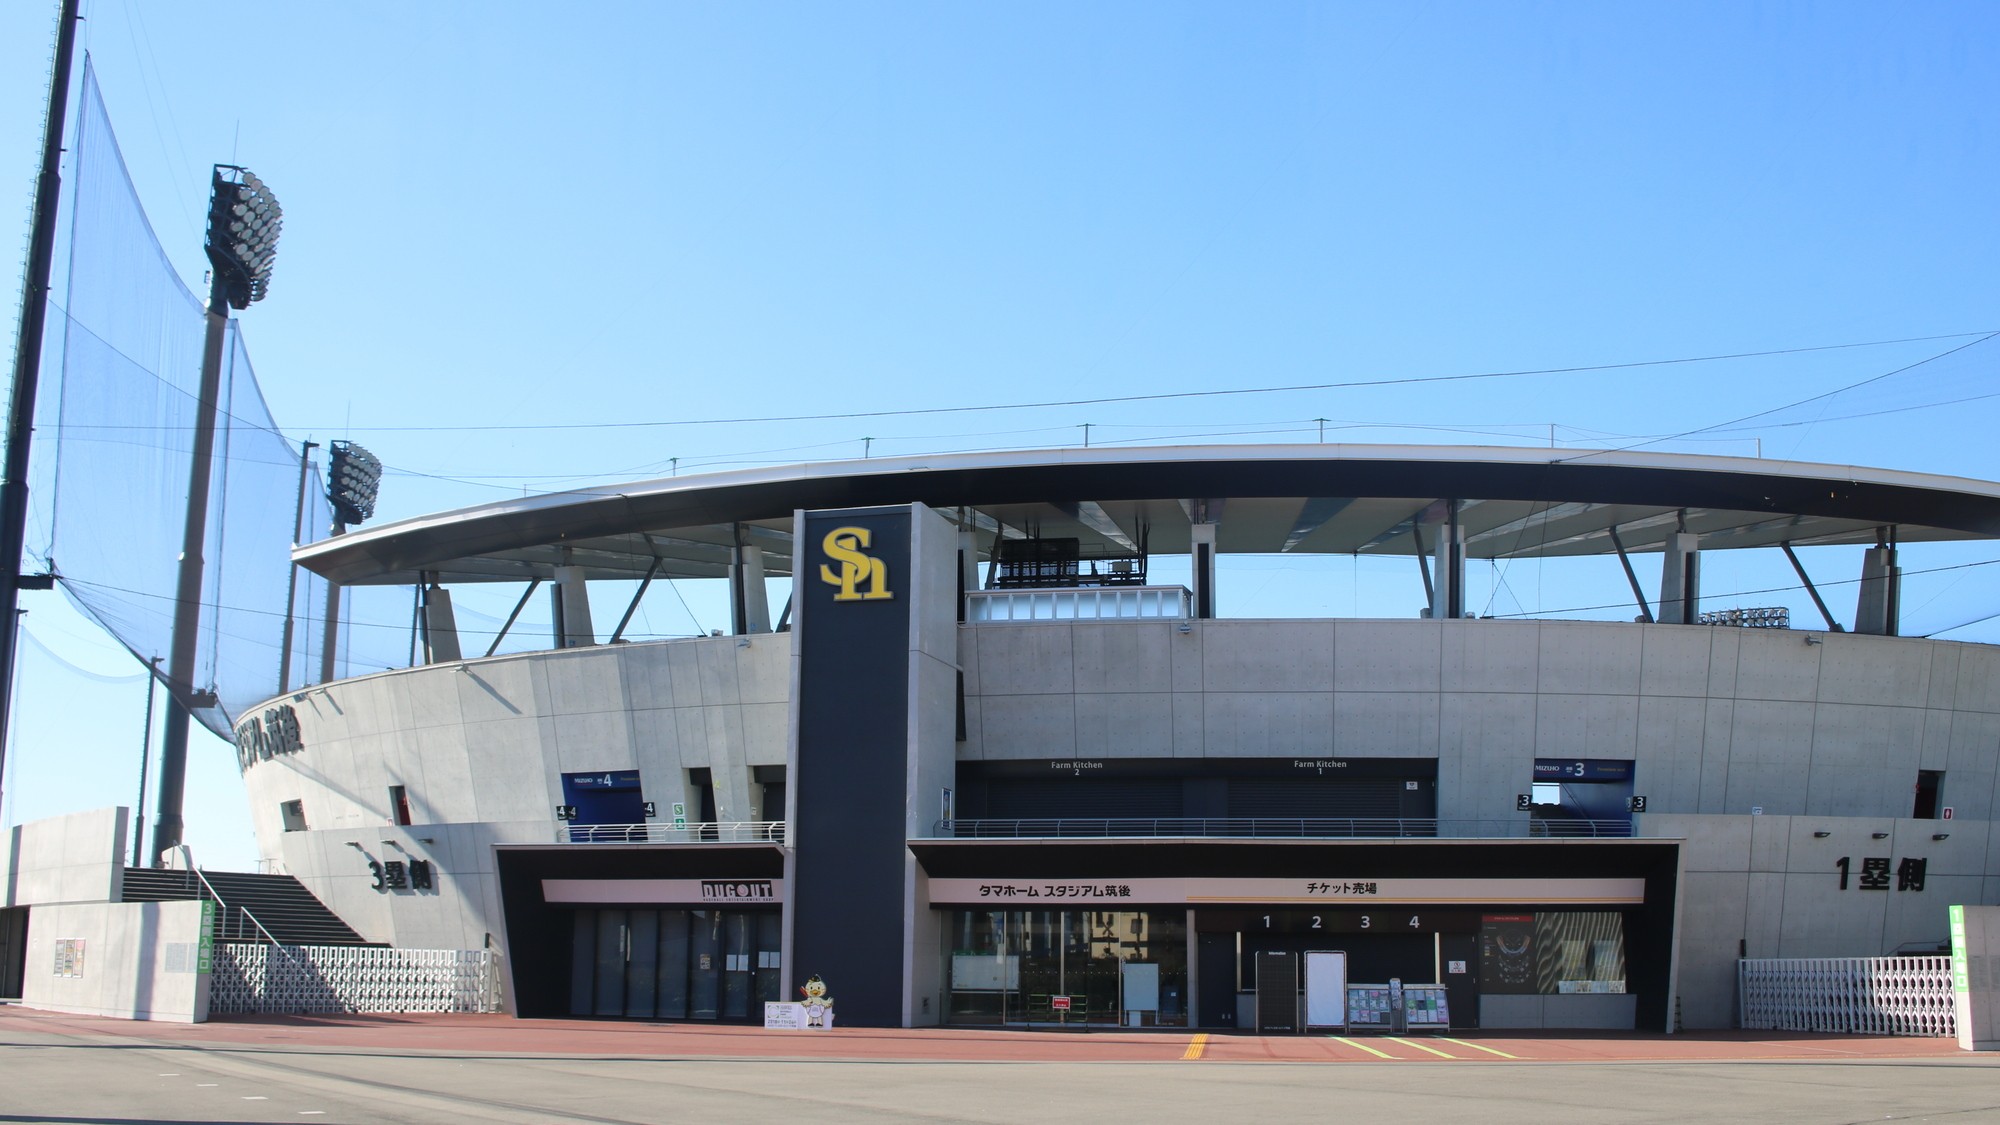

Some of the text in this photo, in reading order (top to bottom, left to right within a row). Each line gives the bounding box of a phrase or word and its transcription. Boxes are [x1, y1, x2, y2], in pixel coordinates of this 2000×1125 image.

[1051, 761, 1103, 769] Farm Kitchen
[1294, 760, 1347, 768] Farm Kitchen
[1574, 762, 1584, 777] 3
[1074, 768, 1079, 776] 2
[603, 774, 613, 787] 4
[1521, 795, 1529, 806] 3
[1636, 797, 1644, 808] 3
[559, 806, 566, 816] 4
[647, 803, 653, 813] 4
[1836, 857, 1928, 892] 1塁側
[702, 883, 771, 897] DUGOUT
[979, 884, 1131, 897] タマホーム スタジアム筑後
[1307, 882, 1377, 895] チケット売場
[1263, 915, 1420, 928] 1 2 3 4
